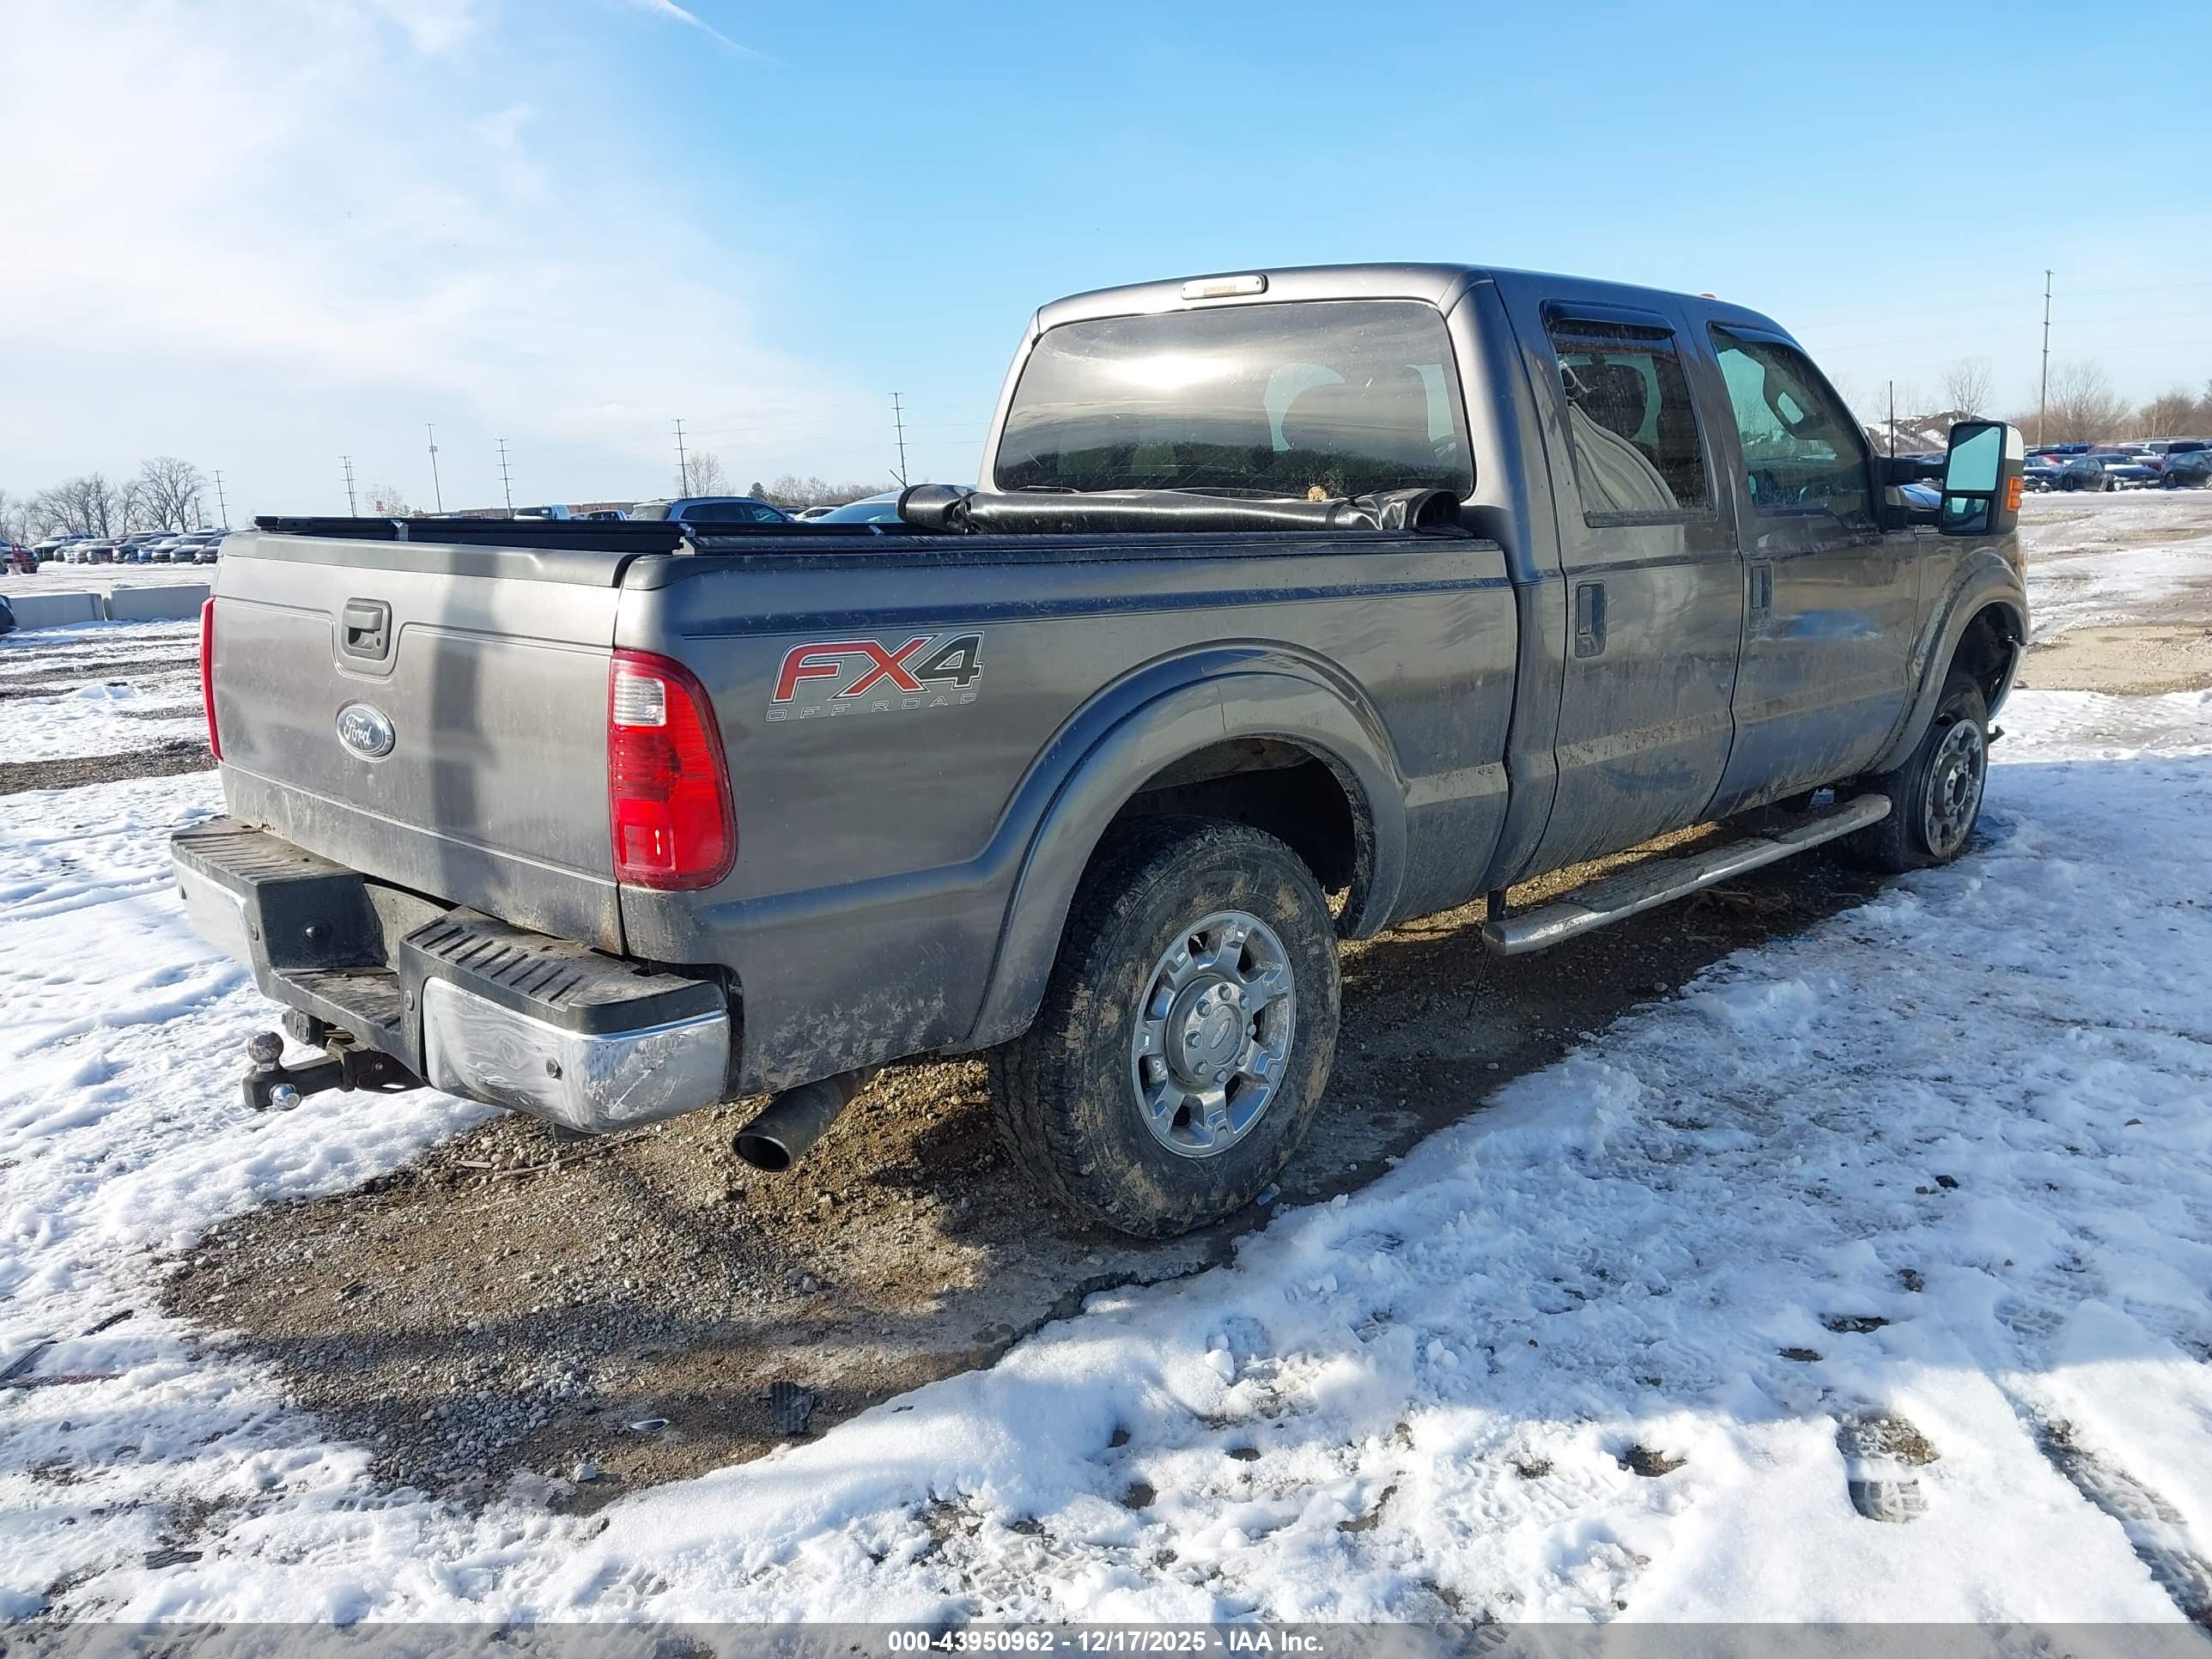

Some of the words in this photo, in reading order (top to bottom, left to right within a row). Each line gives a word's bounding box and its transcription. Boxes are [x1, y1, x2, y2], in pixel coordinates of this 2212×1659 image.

[769, 631, 984, 706] FX4
[766, 703, 851, 722] OFF
[872, 693, 977, 713] ROAD
[343, 714, 372, 745] Ford
